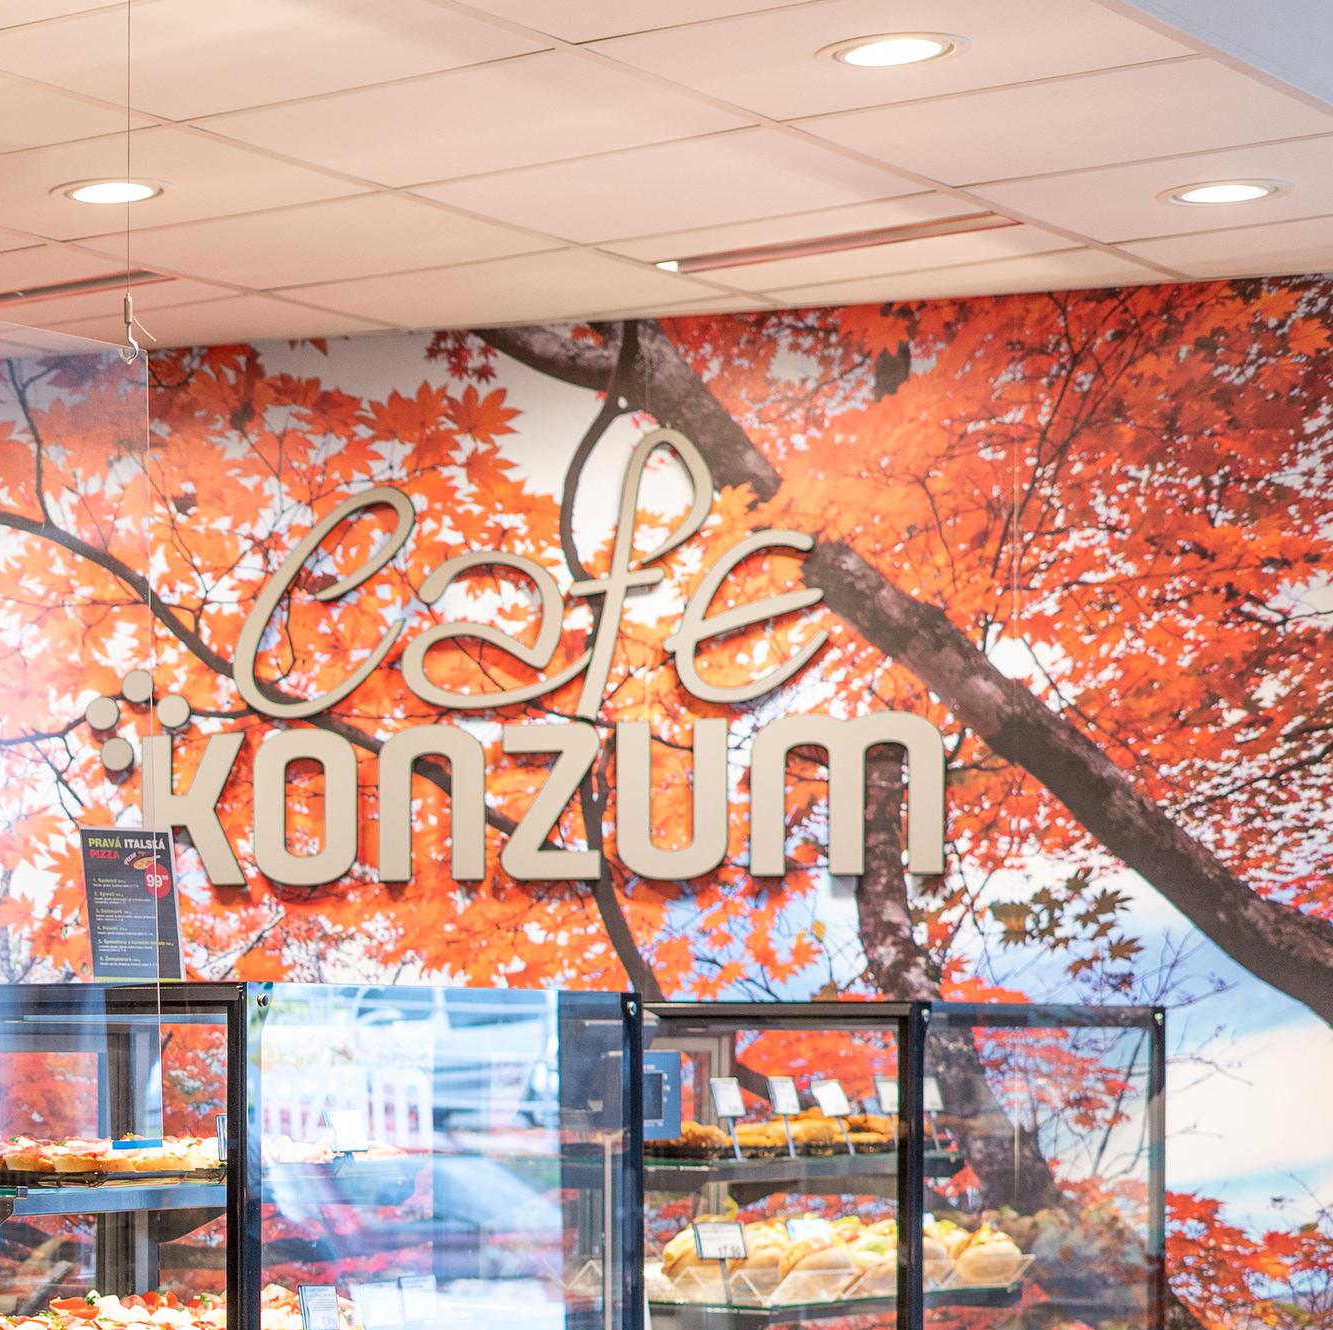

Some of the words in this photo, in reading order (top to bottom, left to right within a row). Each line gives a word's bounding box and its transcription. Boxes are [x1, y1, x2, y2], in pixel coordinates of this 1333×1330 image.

[232, 429, 830, 720] Cafe
[88, 836, 122, 848] PRAVÁ
[124, 838, 166, 850] ITALSKÁ
[89, 850, 120, 860] PIZZA
